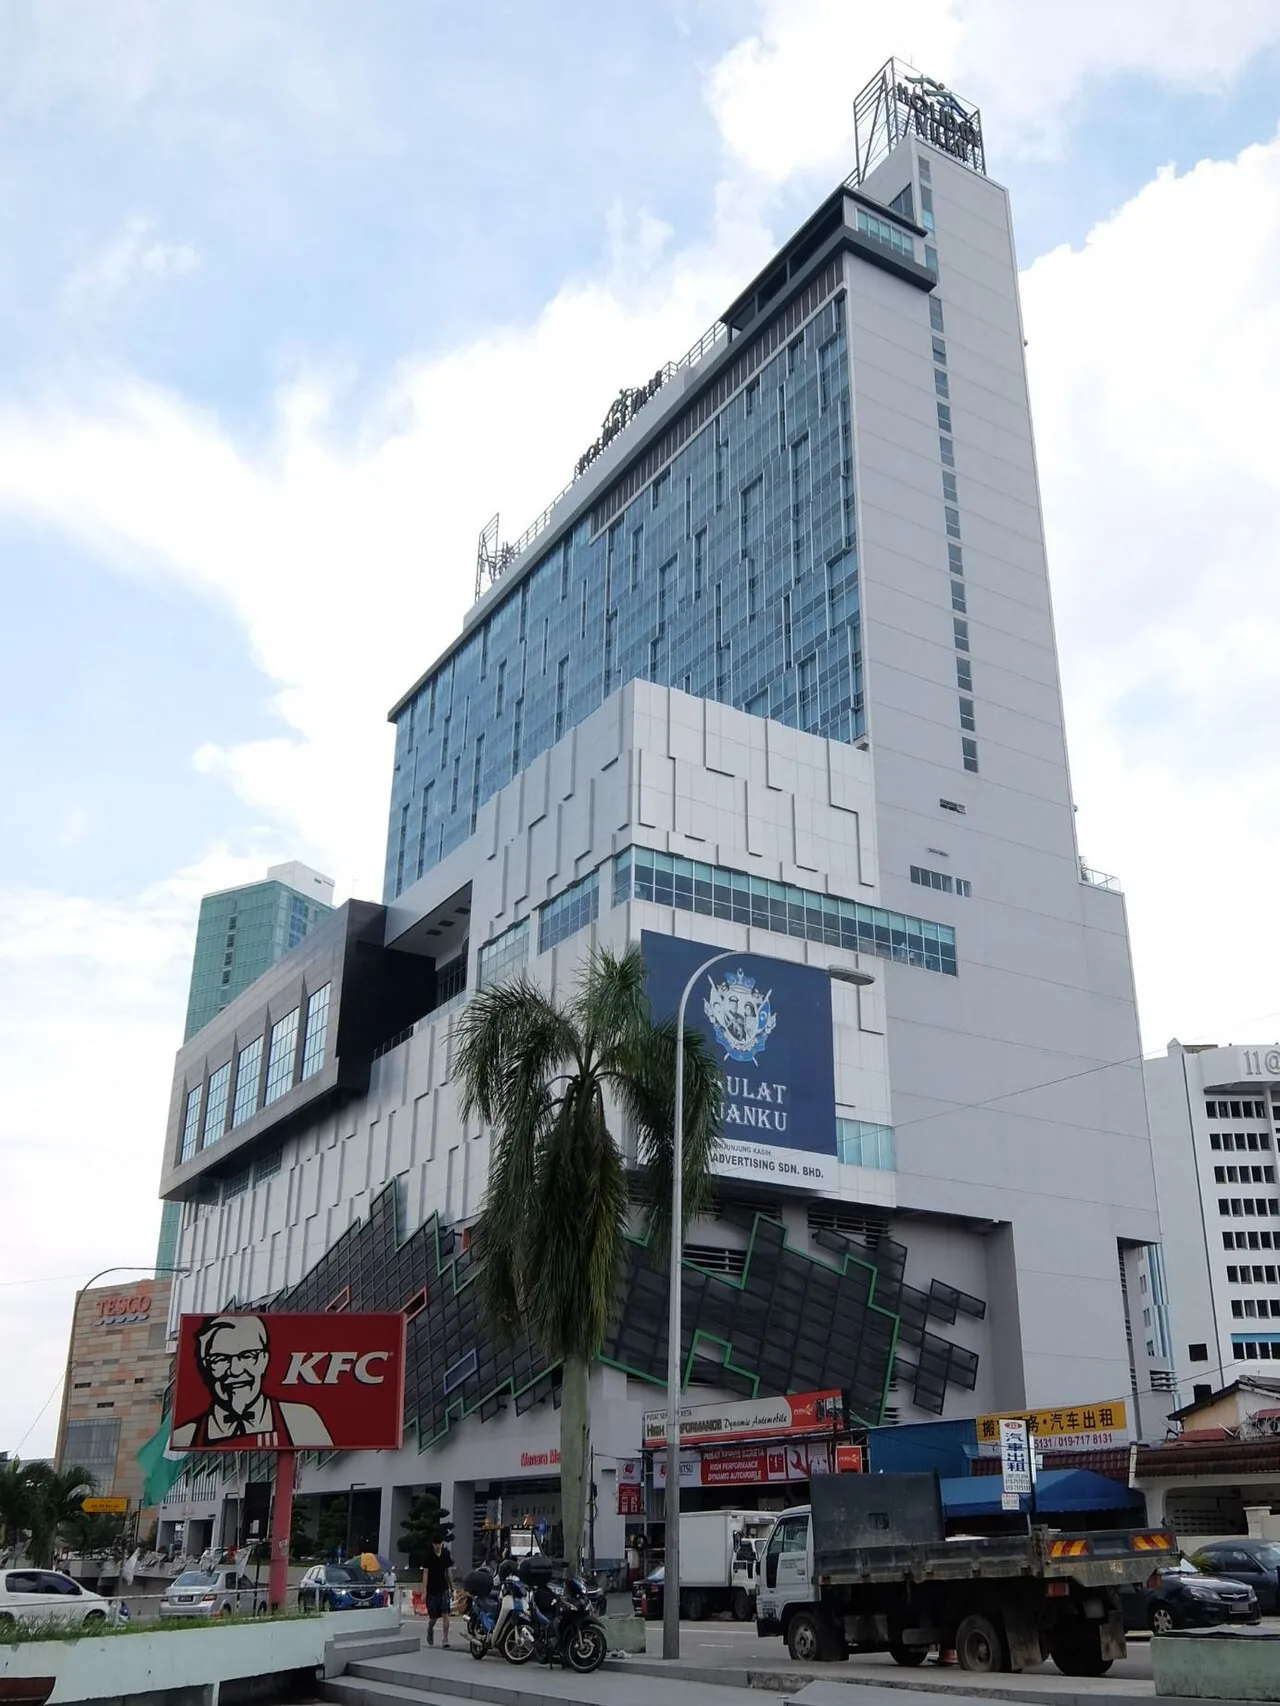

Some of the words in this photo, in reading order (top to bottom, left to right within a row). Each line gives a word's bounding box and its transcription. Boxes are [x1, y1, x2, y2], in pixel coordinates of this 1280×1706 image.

[897, 82, 982, 148] HOLIDAY
[915, 113, 969, 163] VILLA
[778, 1163, 800, 1174] SDN.
[803, 1167, 824, 1178] BHD.
[96, 1295, 152, 1317] TESCO
[281, 1351, 389, 1385] KFC
[723, 1418, 750, 1430] Dynamic
[752, 1413, 787, 1427] Automobile
[722, 1460, 758, 1470] PERFORMANCE
[708, 1472, 729, 1481] DYNAMIC
[731, 1470, 761, 1480] AUTOMOBILE
